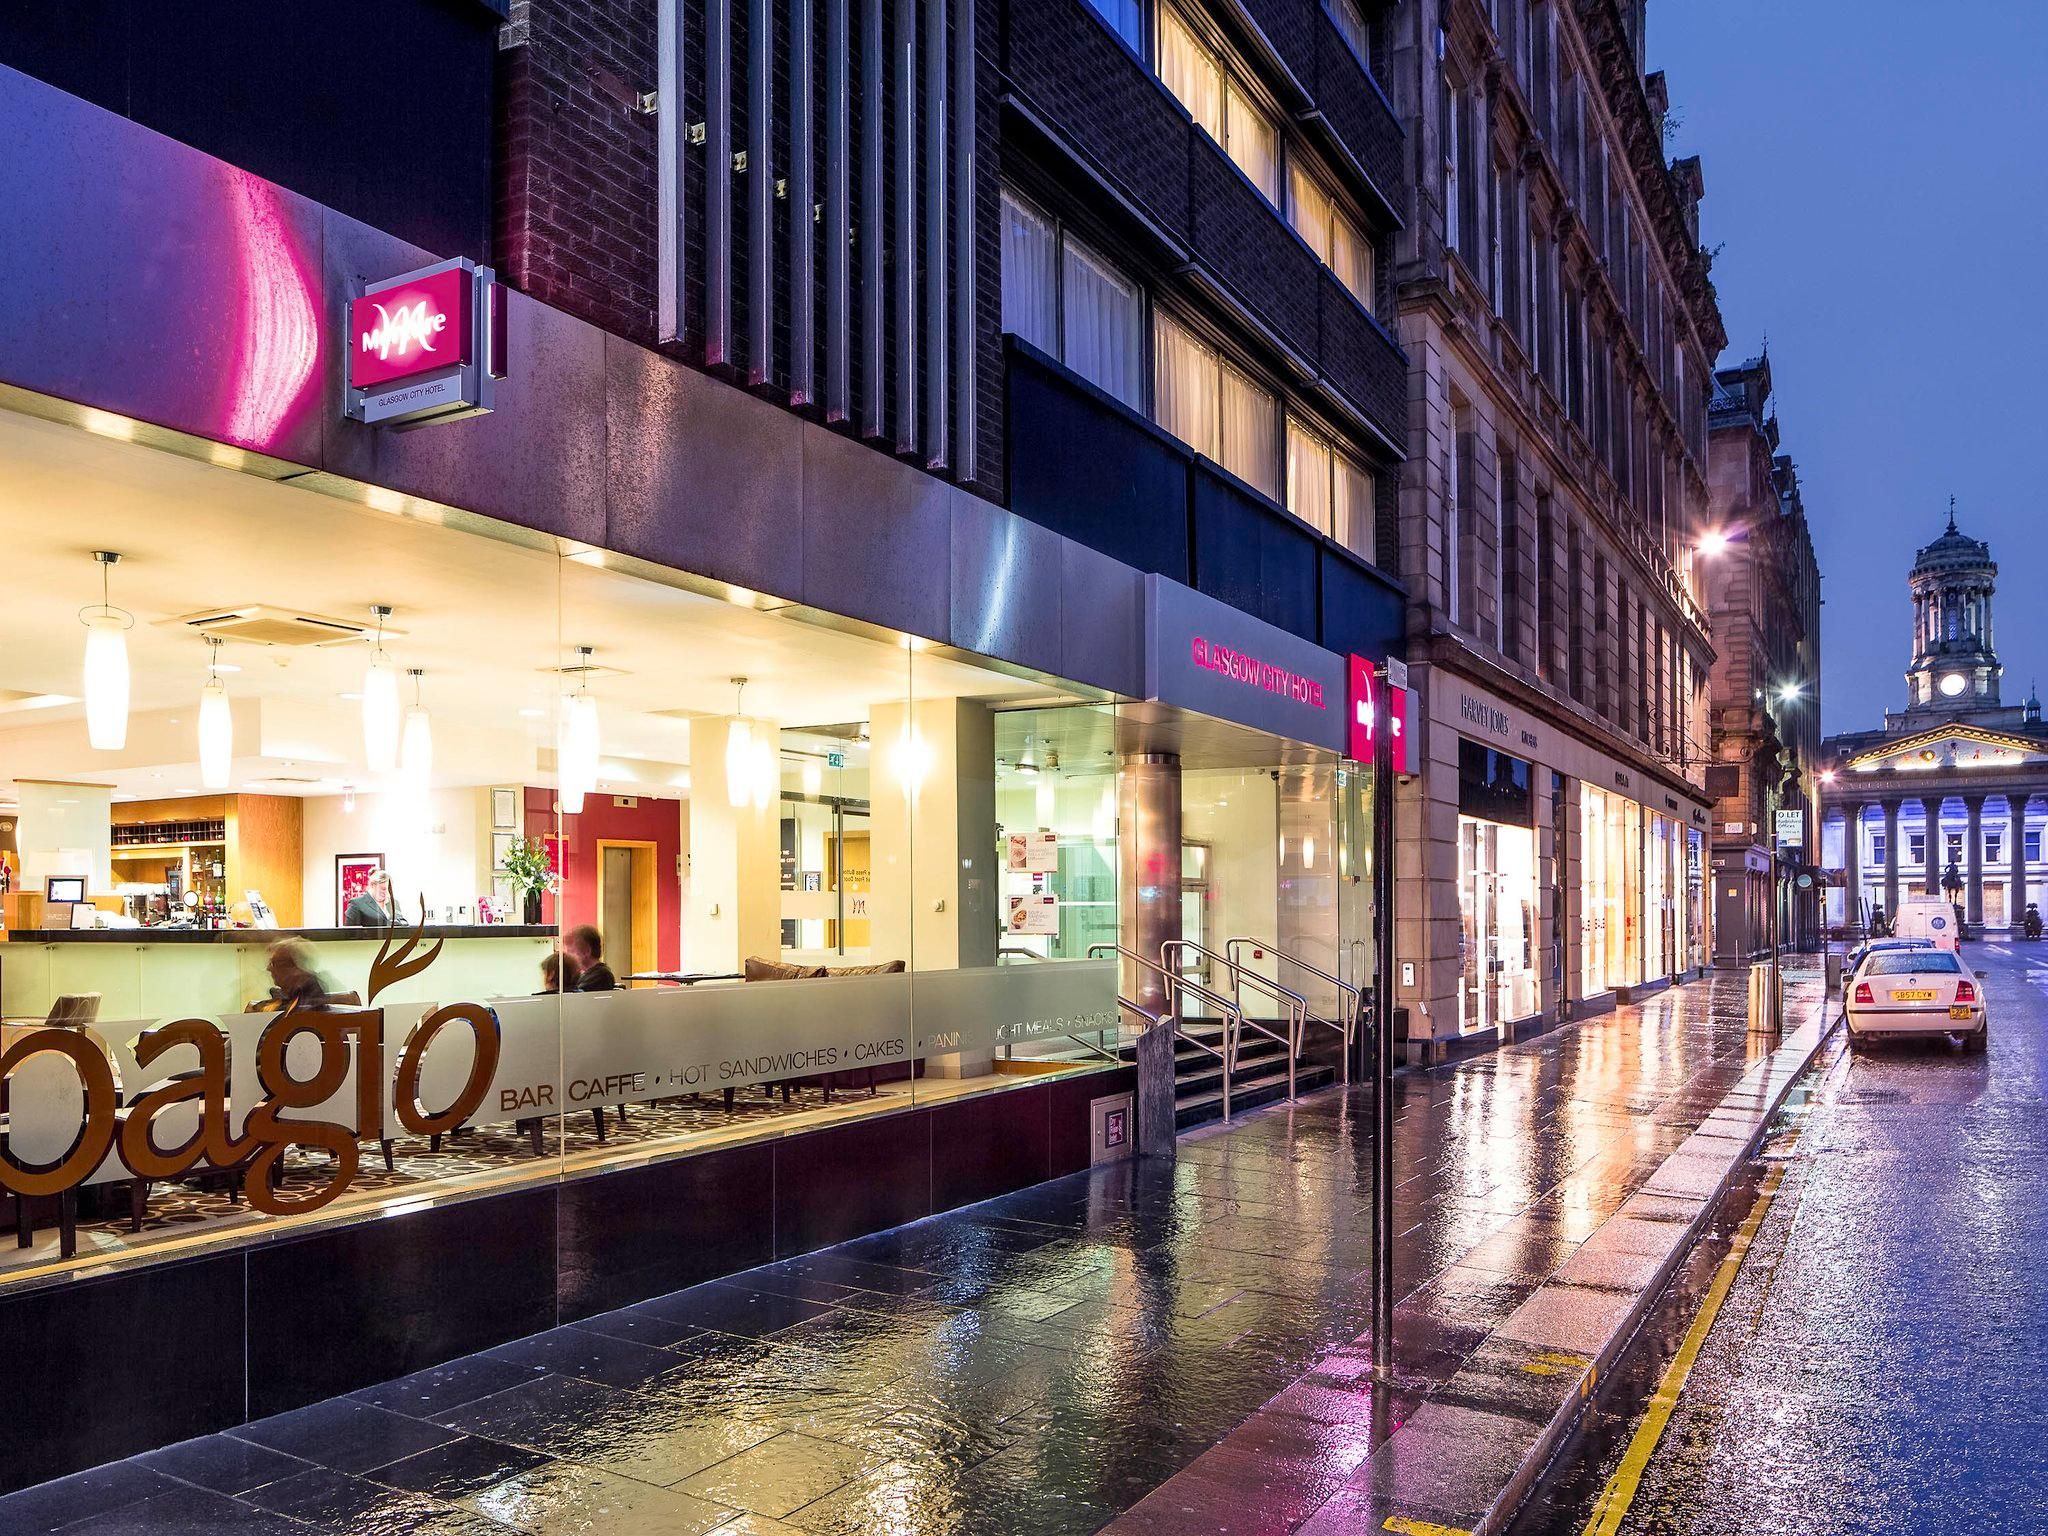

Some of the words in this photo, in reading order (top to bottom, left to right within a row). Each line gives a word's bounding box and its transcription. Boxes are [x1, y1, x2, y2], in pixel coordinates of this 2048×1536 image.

[378, 393, 408, 407] GLASGOW
[410, 388, 424, 399] CITY
[425, 384, 446, 395] HOTEL
[1192, 637, 1260, 686] GLASGOW
[1262, 664, 1290, 696] CITY
[1291, 674, 1327, 710] HOTEL
[1461, 693, 1489, 728] HARVEY
[501, 1085, 553, 1111] BAR
[569, 1072, 645, 1100] CAFFE
[669, 1064, 710, 1086] HOT
[719, 1048, 837, 1080] SANDWICHES
[855, 1039, 904, 1060] CAKES
[1026, 1018, 1064, 1035] MEALS
[1074, 1011, 1115, 1028] SNACKS
